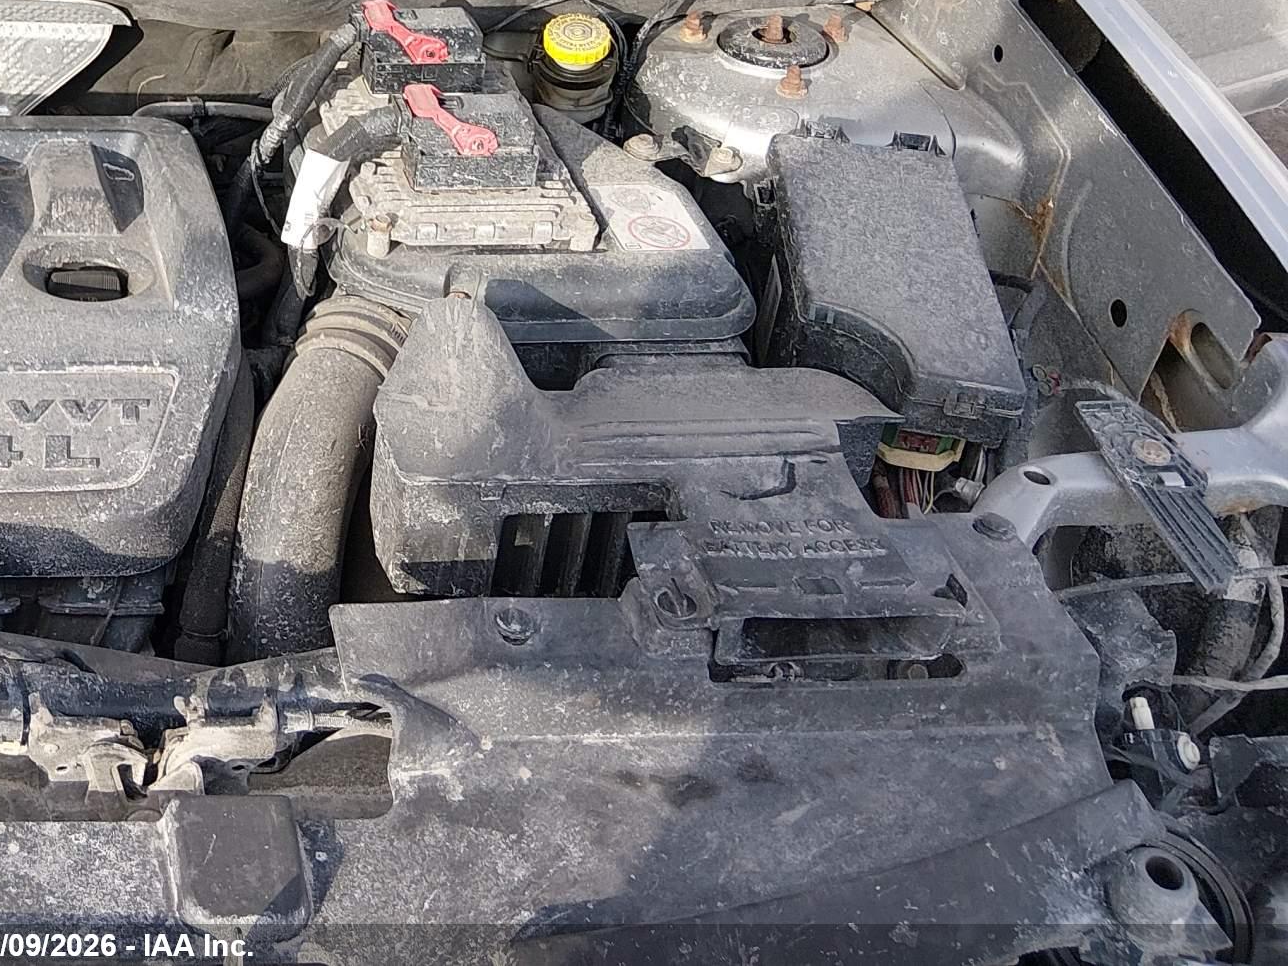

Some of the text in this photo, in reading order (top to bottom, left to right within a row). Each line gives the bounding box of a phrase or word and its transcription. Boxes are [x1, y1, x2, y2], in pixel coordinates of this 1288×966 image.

[8, 399, 150, 425] VVT
[708, 519, 854, 537] REMOVE FOR
[701, 538, 886, 559] BATTERY ACCESS
